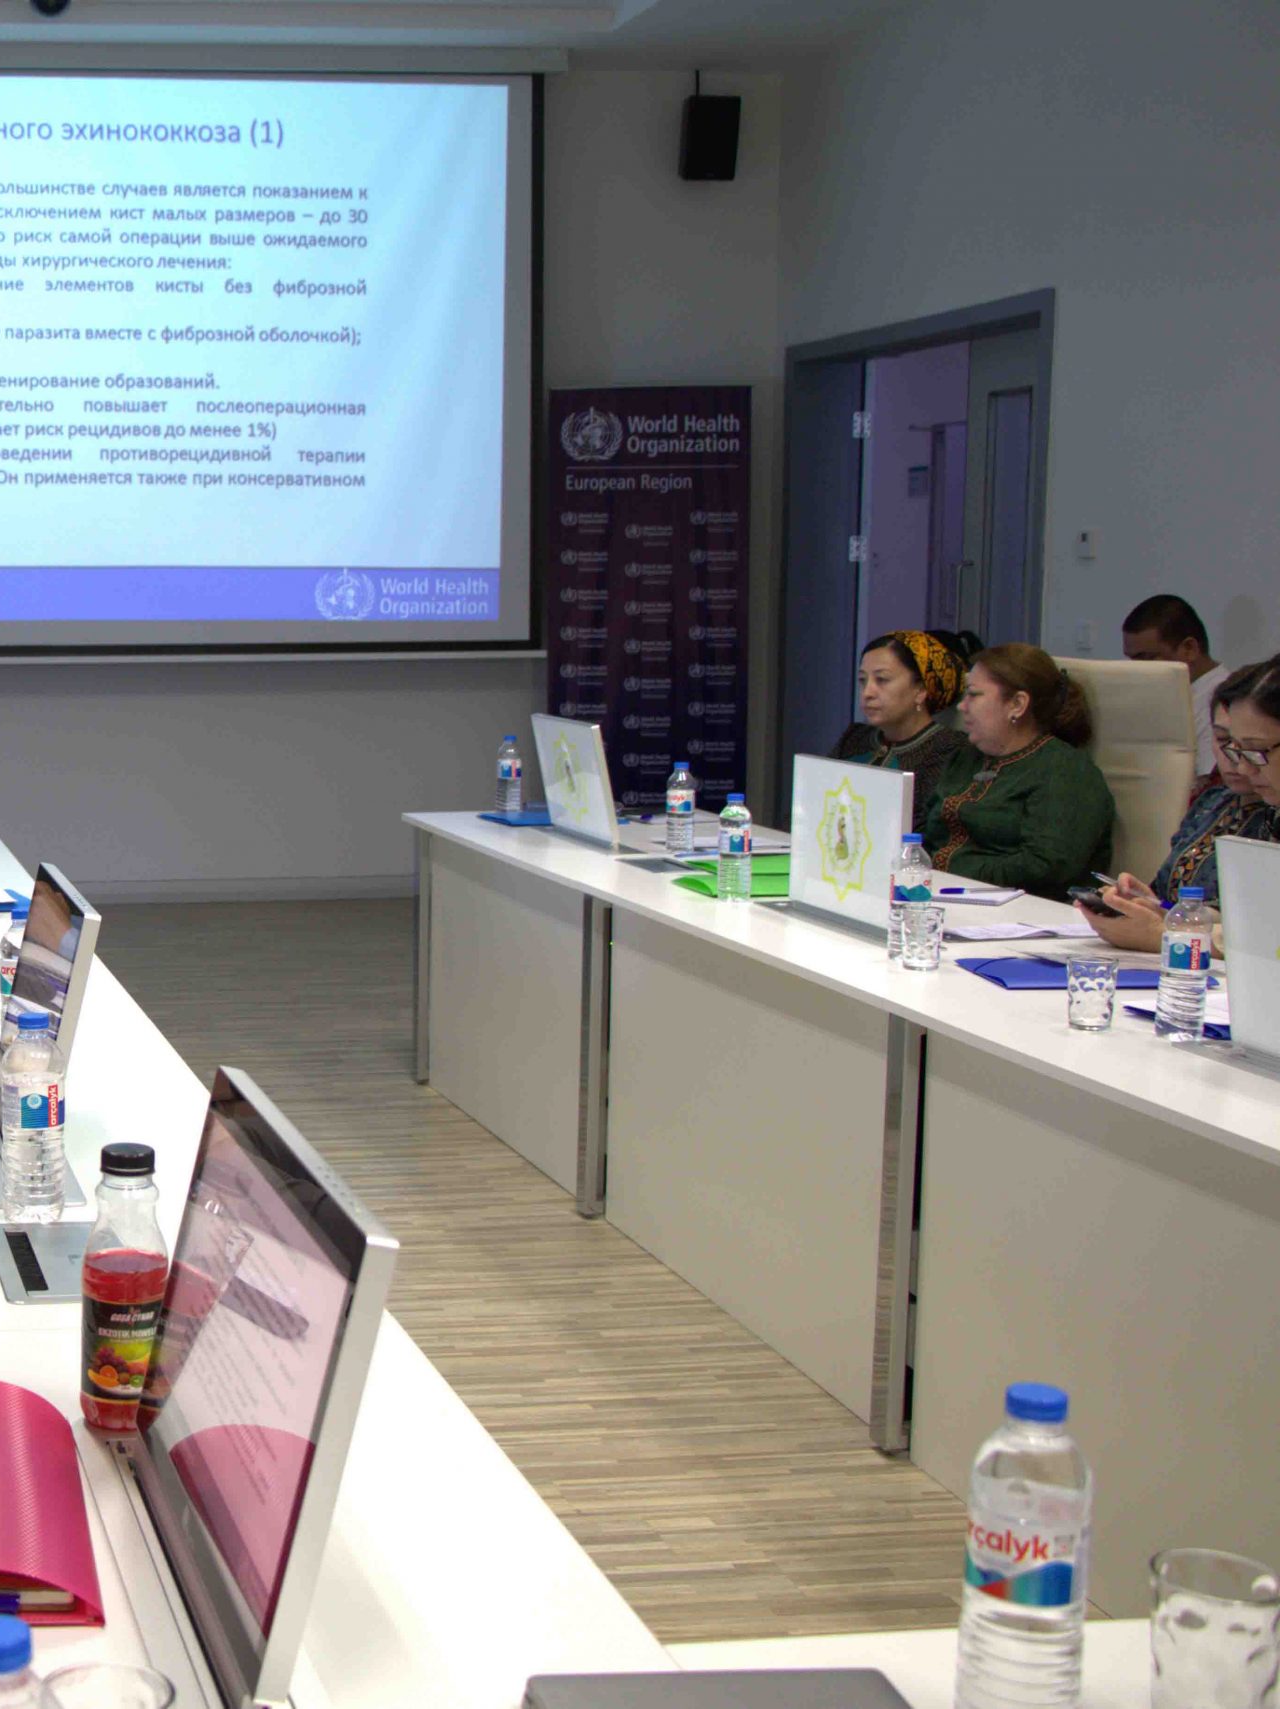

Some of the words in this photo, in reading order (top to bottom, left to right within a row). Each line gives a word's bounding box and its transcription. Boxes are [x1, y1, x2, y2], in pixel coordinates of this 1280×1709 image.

[61, 121, 242, 143] эхинококкоза
[249, 119, 284, 147] (1)
[101, 183, 168, 199] случаев
[173, 184, 247, 198] является
[252, 186, 354, 200] показанием
[358, 188, 368, 200] к
[109, 207, 145, 220] кист
[152, 208, 207, 221] малых
[214, 209, 296, 225] размеров
[319, 210, 342, 226] до
[349, 208, 369, 224] 30
[13, 231, 52, 246] риск
[59, 227, 112, 244] самой
[119, 231, 202, 248] операции
[209, 233, 256, 246] выше
[262, 233, 368, 249] ожидаемого
[22, 255, 154, 271] хирургического
[156, 257, 231, 270] лечения:
[45, 280, 135, 293] элементов
[155, 280, 204, 294] кисты
[224, 278, 253, 294] без
[272, 279, 367, 299] фиброзной
[4, 327, 81, 343] паразита
[85, 328, 143, 341] вместе
[147, 328, 157, 341] с
[160, 325, 256, 345] фиброзной
[258, 326, 361, 346] оболочкой);
[104, 372, 220, 392] образований.
[83, 400, 168, 413] повышает
[196, 400, 367, 417] послеоперационная
[24, 424, 65, 440] риск
[67, 424, 163, 440] рецидивов
[163, 424, 186, 440] до
[189, 426, 242, 438] менее
[247, 421, 277, 441] 1%)
[627, 415, 678, 433] World
[683, 413, 740, 433] Health
[99, 444, 272, 465] противорецидивной
[297, 450, 366, 466] терапии
[627, 434, 740, 458] Organization
[24, 472, 133, 488] применяется
[137, 472, 188, 486] также
[192, 473, 223, 489] при
[227, 473, 366, 489] консервативном
[565, 474, 635, 494] European
[640, 472, 693, 494] Region
[380, 577, 429, 595] World
[435, 577, 489, 595] Health
[380, 597, 489, 619] Organization
